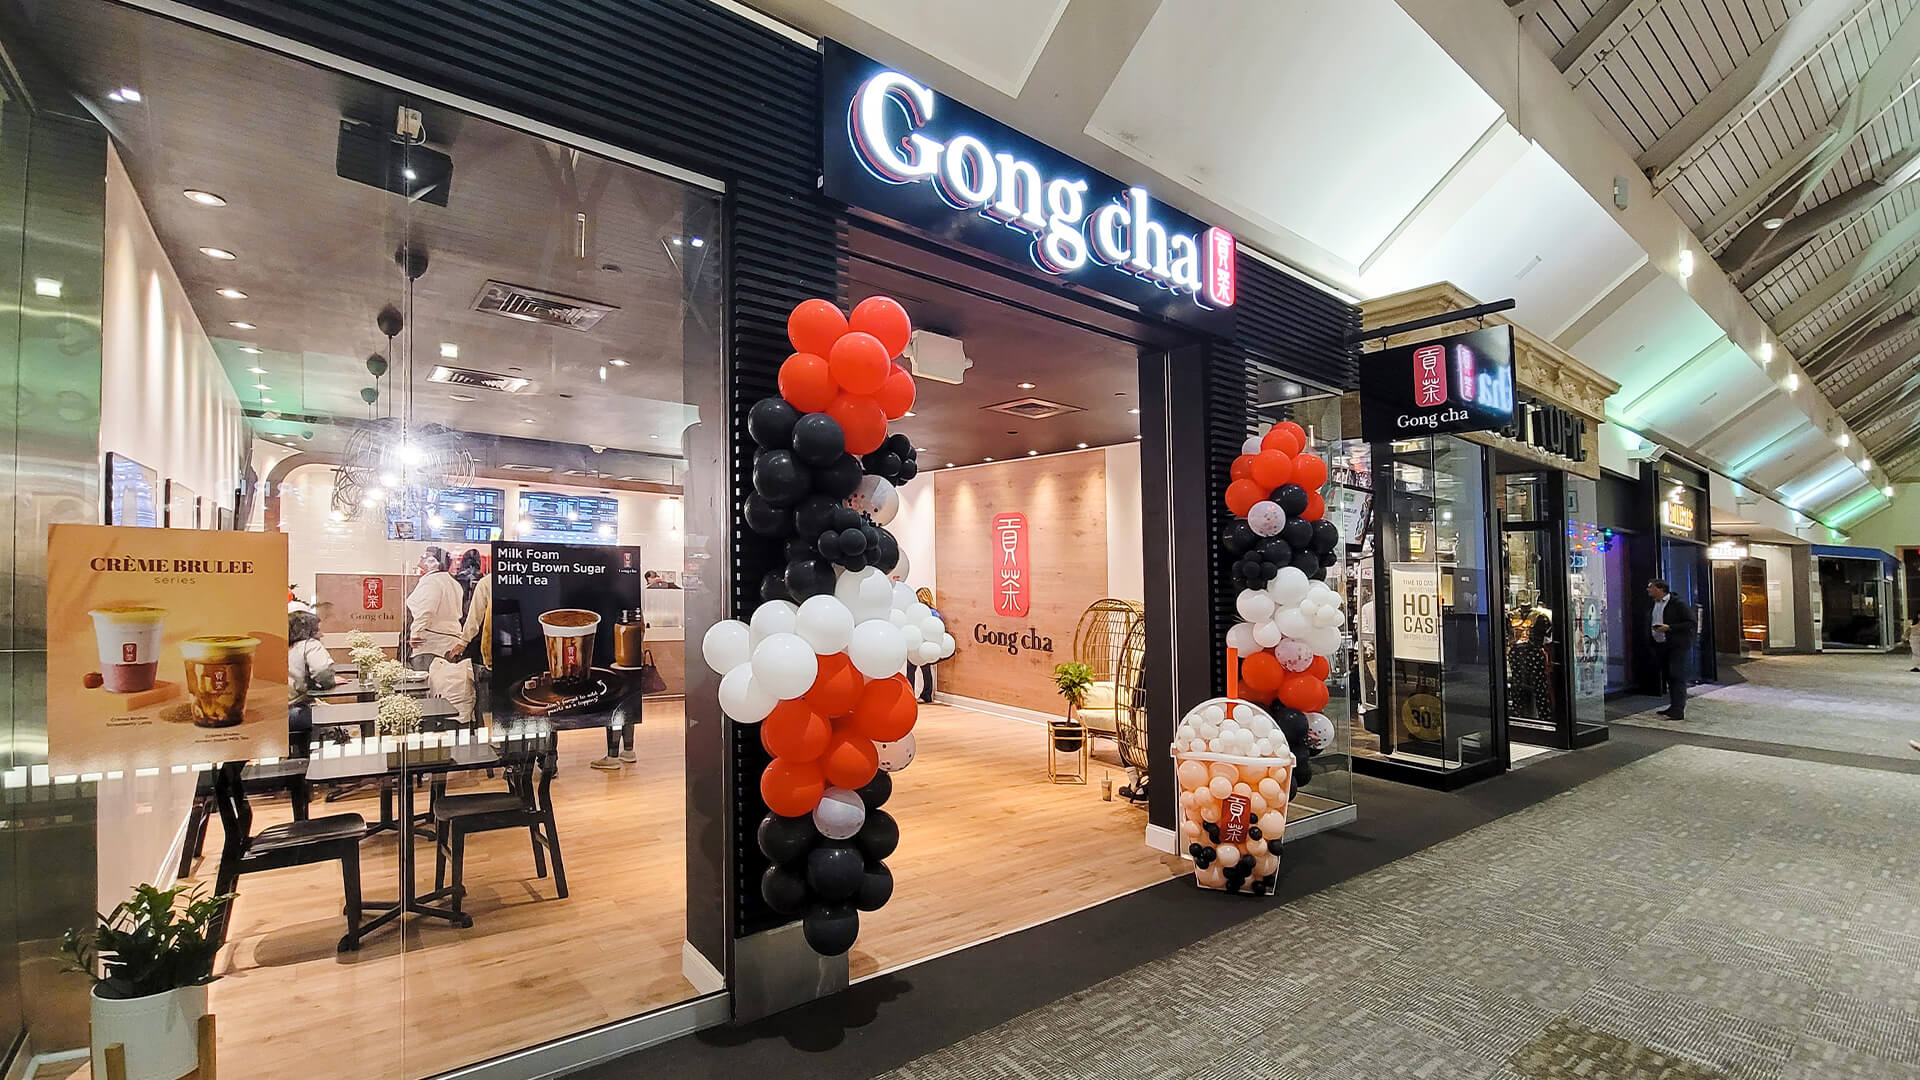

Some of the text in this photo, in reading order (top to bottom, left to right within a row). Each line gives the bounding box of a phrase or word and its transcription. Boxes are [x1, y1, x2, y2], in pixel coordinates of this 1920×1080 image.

[858, 70, 1203, 292] Gong cha
[1417, 348, 1440, 404] 貢茶
[1397, 407, 1469, 429] Gong cha
[90, 555, 254, 574] CRÈME BRULEE
[497, 548, 559, 560] Milk Foam
[997, 518, 1021, 611] 貢茶
[497, 561, 528, 574] Dirty
[532, 562, 570, 573] Brown
[573, 563, 606, 575] Sugar
[154, 576, 196, 585] series
[497, 574, 548, 585] Milk Tea
[974, 623, 1053, 655] Gong cha
[1225, 796, 1247, 842] 貢茶
